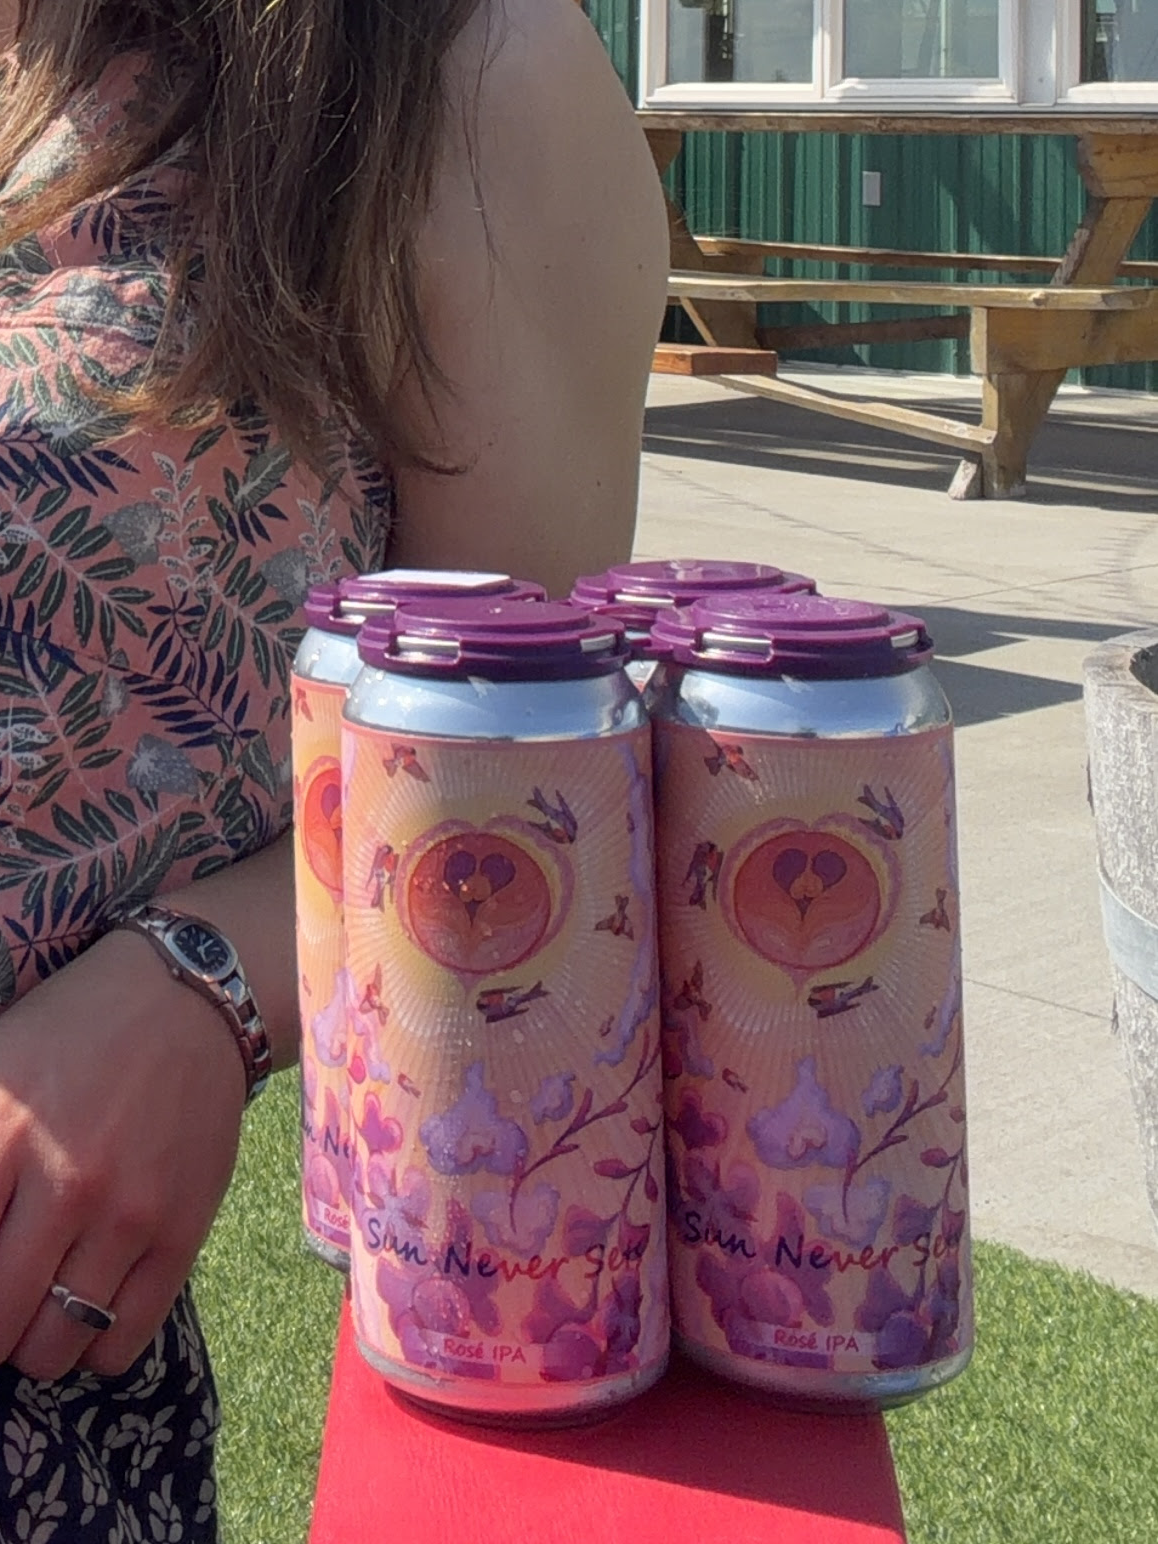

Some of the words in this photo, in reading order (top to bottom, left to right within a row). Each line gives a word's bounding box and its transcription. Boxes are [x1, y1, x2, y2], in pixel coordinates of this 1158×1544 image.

[366, 1217, 428, 1266] Sun
[443, 1241, 570, 1283] Never
[684, 1210, 756, 1258] Sun
[774, 1236, 899, 1272] Never
[443, 1337, 485, 1360] Rosé
[492, 1343, 527, 1364] IPA
[773, 1328, 818, 1351] Rosé
[825, 1332, 859, 1353] IPA
